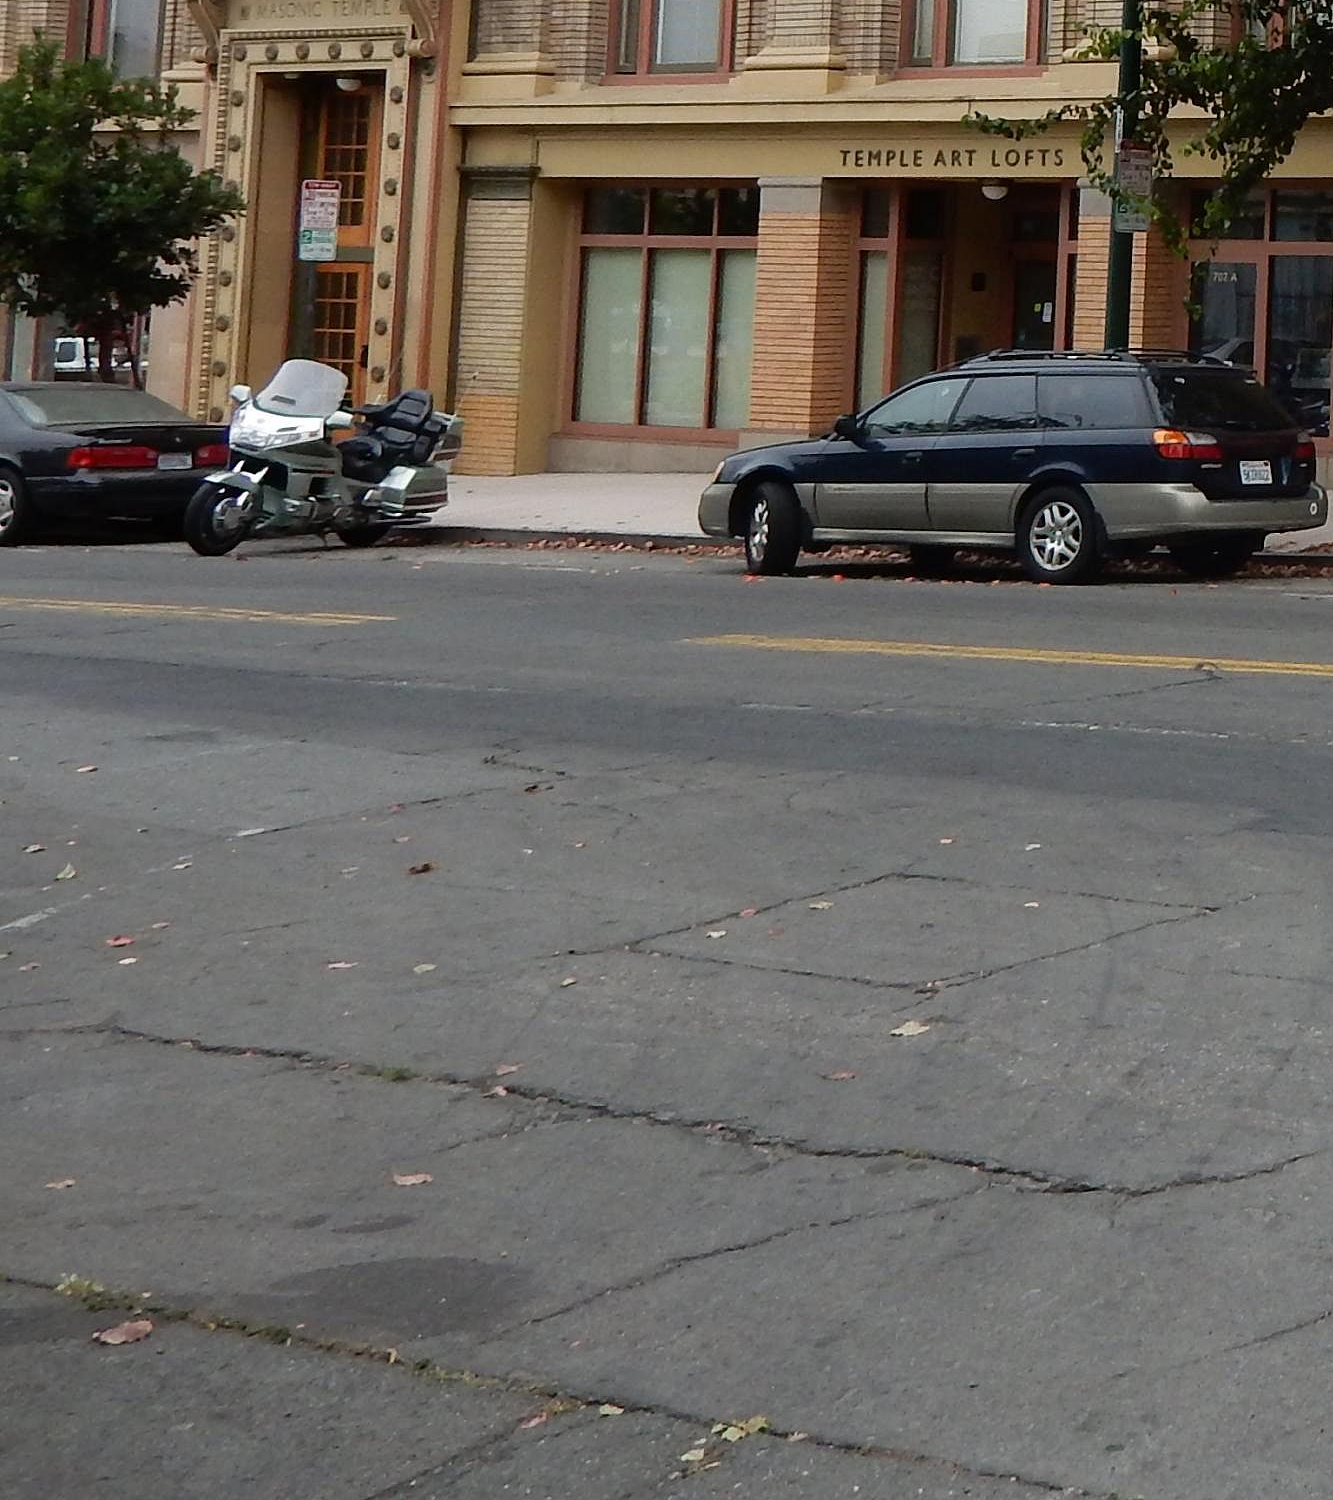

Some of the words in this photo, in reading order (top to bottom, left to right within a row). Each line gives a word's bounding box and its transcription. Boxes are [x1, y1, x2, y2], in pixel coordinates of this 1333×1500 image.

[256, 1, 323, 20] MASONIC
[332, 0, 392, 17] TEMPLE
[839, 149, 923, 167] TEMPLE
[933, 149, 977, 167] ART
[991, 148, 1065, 167] LOFTS
